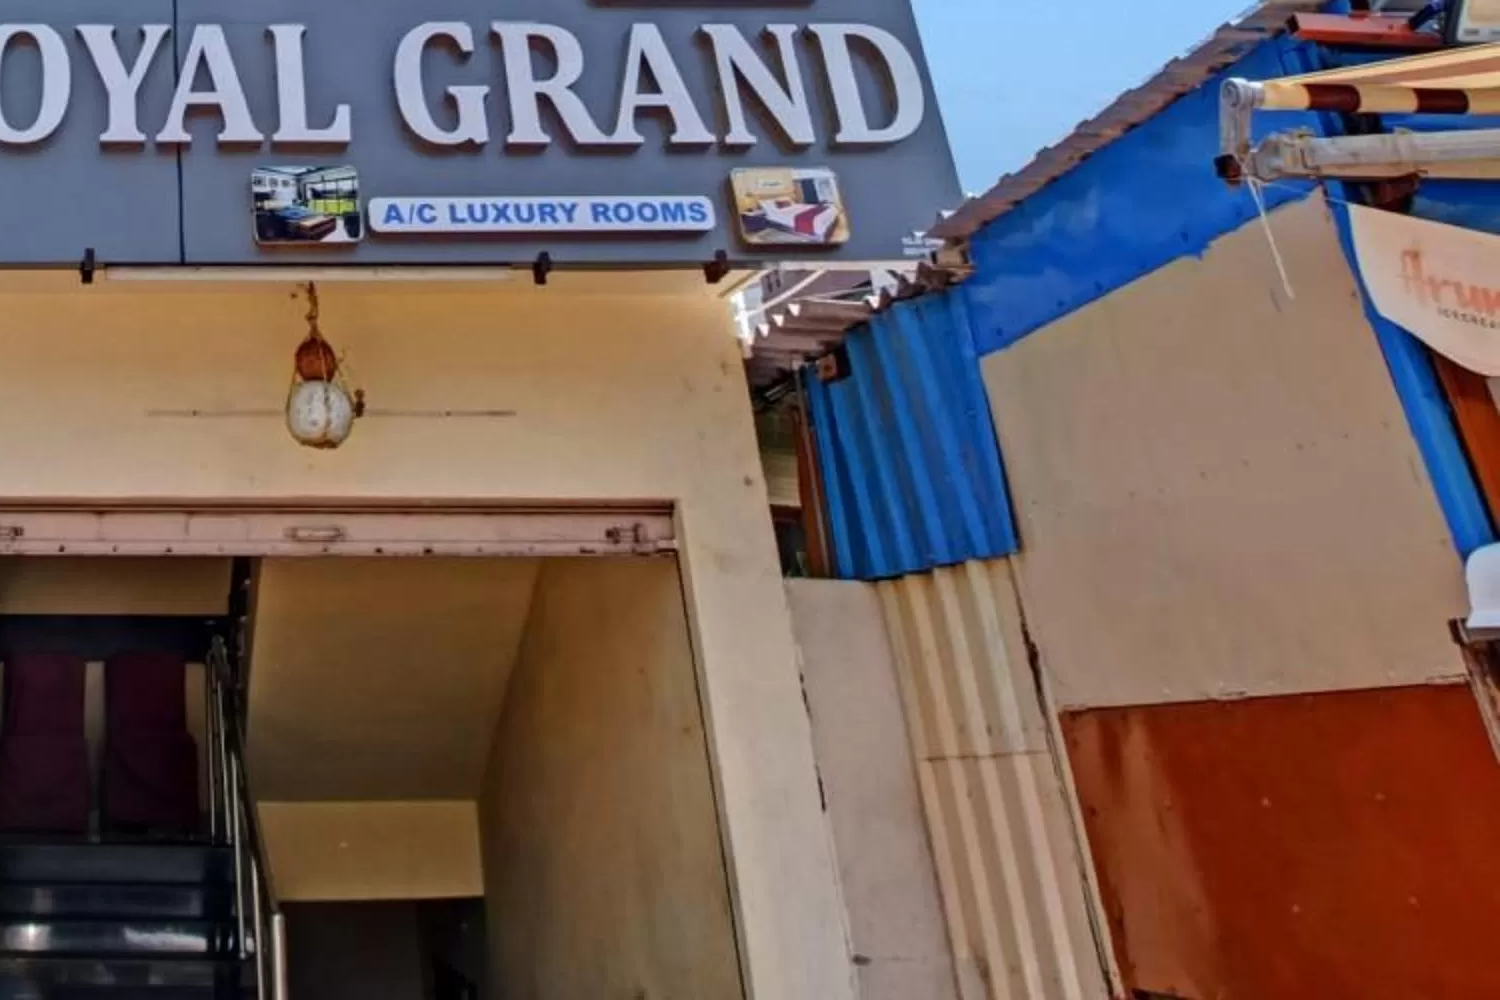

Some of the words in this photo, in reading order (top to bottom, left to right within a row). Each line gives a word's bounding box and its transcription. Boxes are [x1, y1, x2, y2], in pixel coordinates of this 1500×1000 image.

[393, 21, 926, 147] GRAND
[383, 203, 437, 225] A/C
[448, 202, 579, 224] LUXURY
[591, 201, 708, 224] ROOMS
